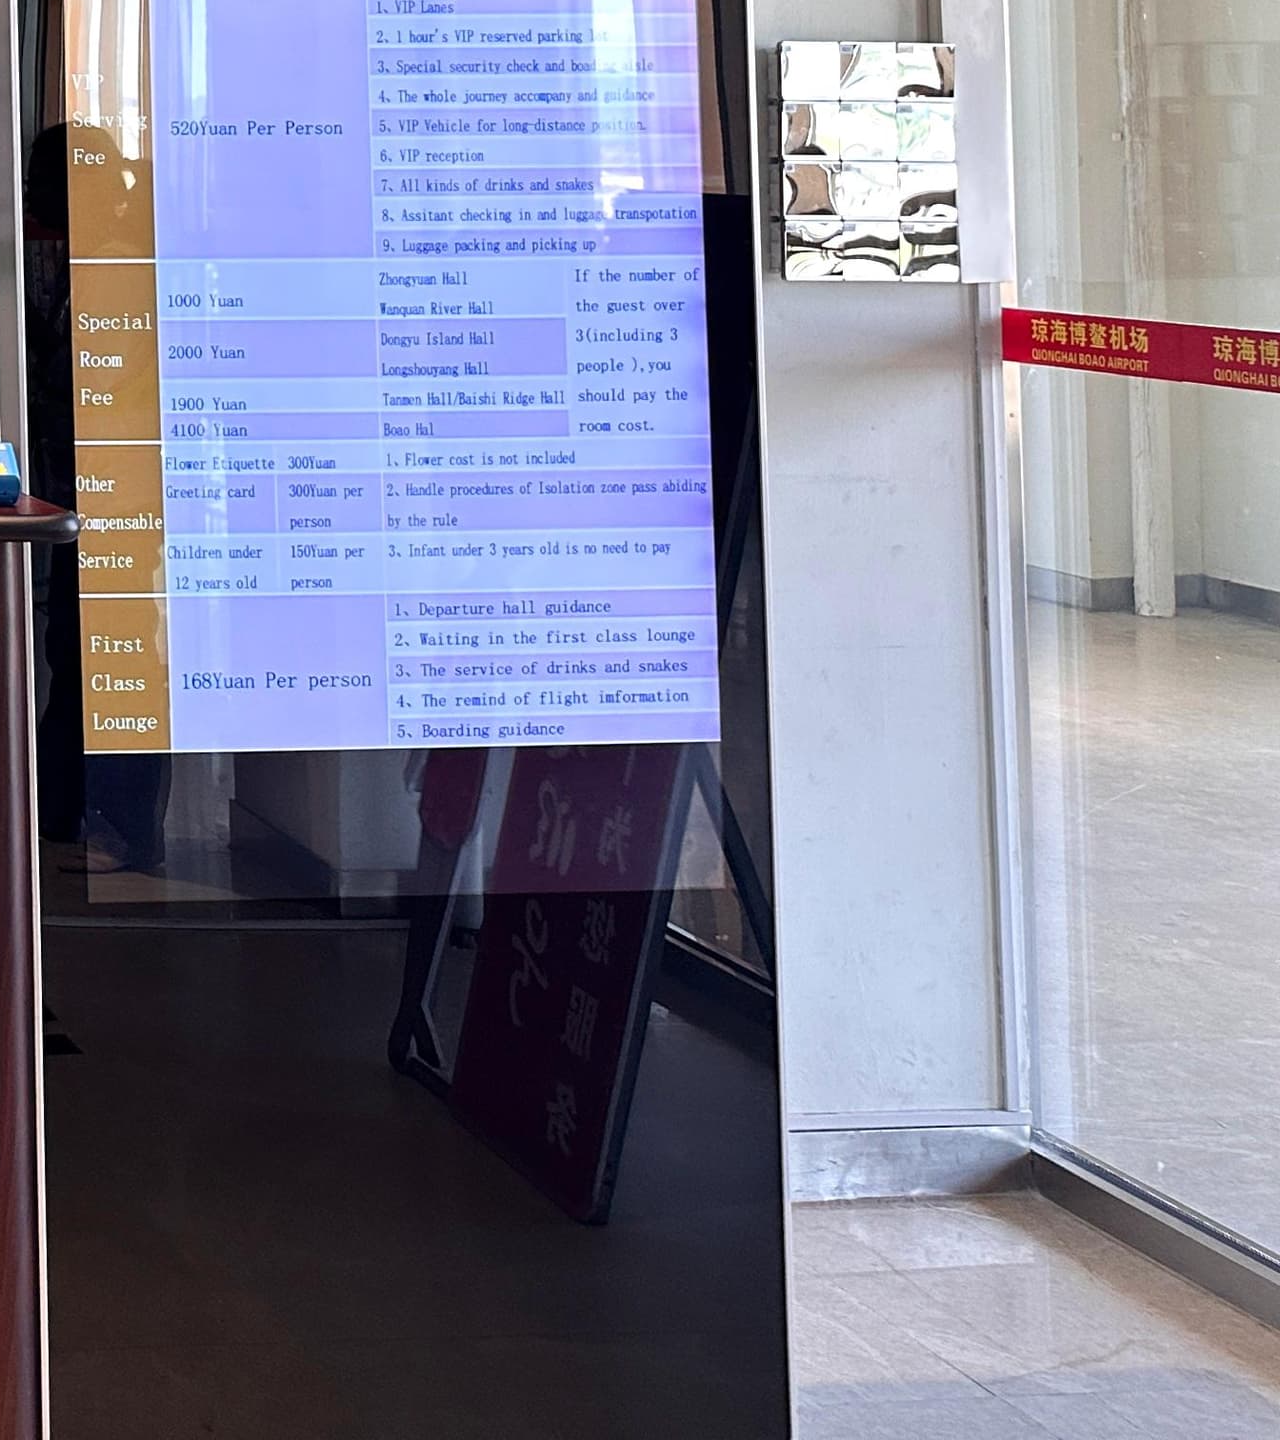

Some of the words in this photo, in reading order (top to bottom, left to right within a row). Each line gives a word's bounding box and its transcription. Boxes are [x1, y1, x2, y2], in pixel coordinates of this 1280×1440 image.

[170, 120, 237, 136] 520Yuan
[247, 120, 276, 136] Per
[286, 120, 343, 136] Person
[73, 150, 105, 165] Fee
[442, 272, 468, 285] Hall
[575, 270, 591, 282] If
[598, 269, 622, 282] the
[629, 269, 676, 281] number
[683, 268, 699, 281] of
[168, 295, 201, 307] 1000
[209, 295, 243, 307] Yuan
[576, 300, 599, 312] the
[606, 300, 645, 314] guest
[653, 300, 686, 312] over
[430, 302, 462, 315] River
[468, 302, 493, 315] Hall
[78, 313, 152, 333] Special
[381, 333, 420, 347] Dongyu
[426, 332, 464, 345] Island
[469, 332, 494, 344] Hall
[576, 329, 663, 343] 3(including
[670, 329, 678, 342] 3
[1031, 318, 1148, 353] 琼海博鳌机场
[80, 351, 123, 368] Room
[168, 346, 202, 359] 2000
[211, 346, 245, 359] Yuan
[577, 360, 624, 374] people
[1032, 348, 1077, 363] QIONGHAI
[1079, 353, 1105, 367] BOAO
[1108, 357, 1149, 372] AIRPORT
[464, 362, 489, 375] Hall
[1214, 368, 1268, 386] QIONGHAI
[80, 389, 113, 405] Fee
[578, 389, 625, 402] should
[633, 390, 656, 404] pay
[665, 388, 688, 401] the
[171, 398, 204, 411] 1900
[213, 398, 247, 411] Yuan
[170, 424, 205, 437] 4100
[213, 424, 247, 437] Yuan
[384, 423, 410, 436] Boao
[416, 423, 434, 436] Hal
[579, 420, 611, 432] room
[618, 420, 654, 432] cost.
[90, 637, 144, 653] First
[91, 674, 145, 691] Class
[182, 673, 255, 690] 168Yuan
[266, 673, 297, 688] Per
[308, 674, 372, 691] person
[93, 713, 158, 731] Lounge
[499, 723, 565, 737] guidance
